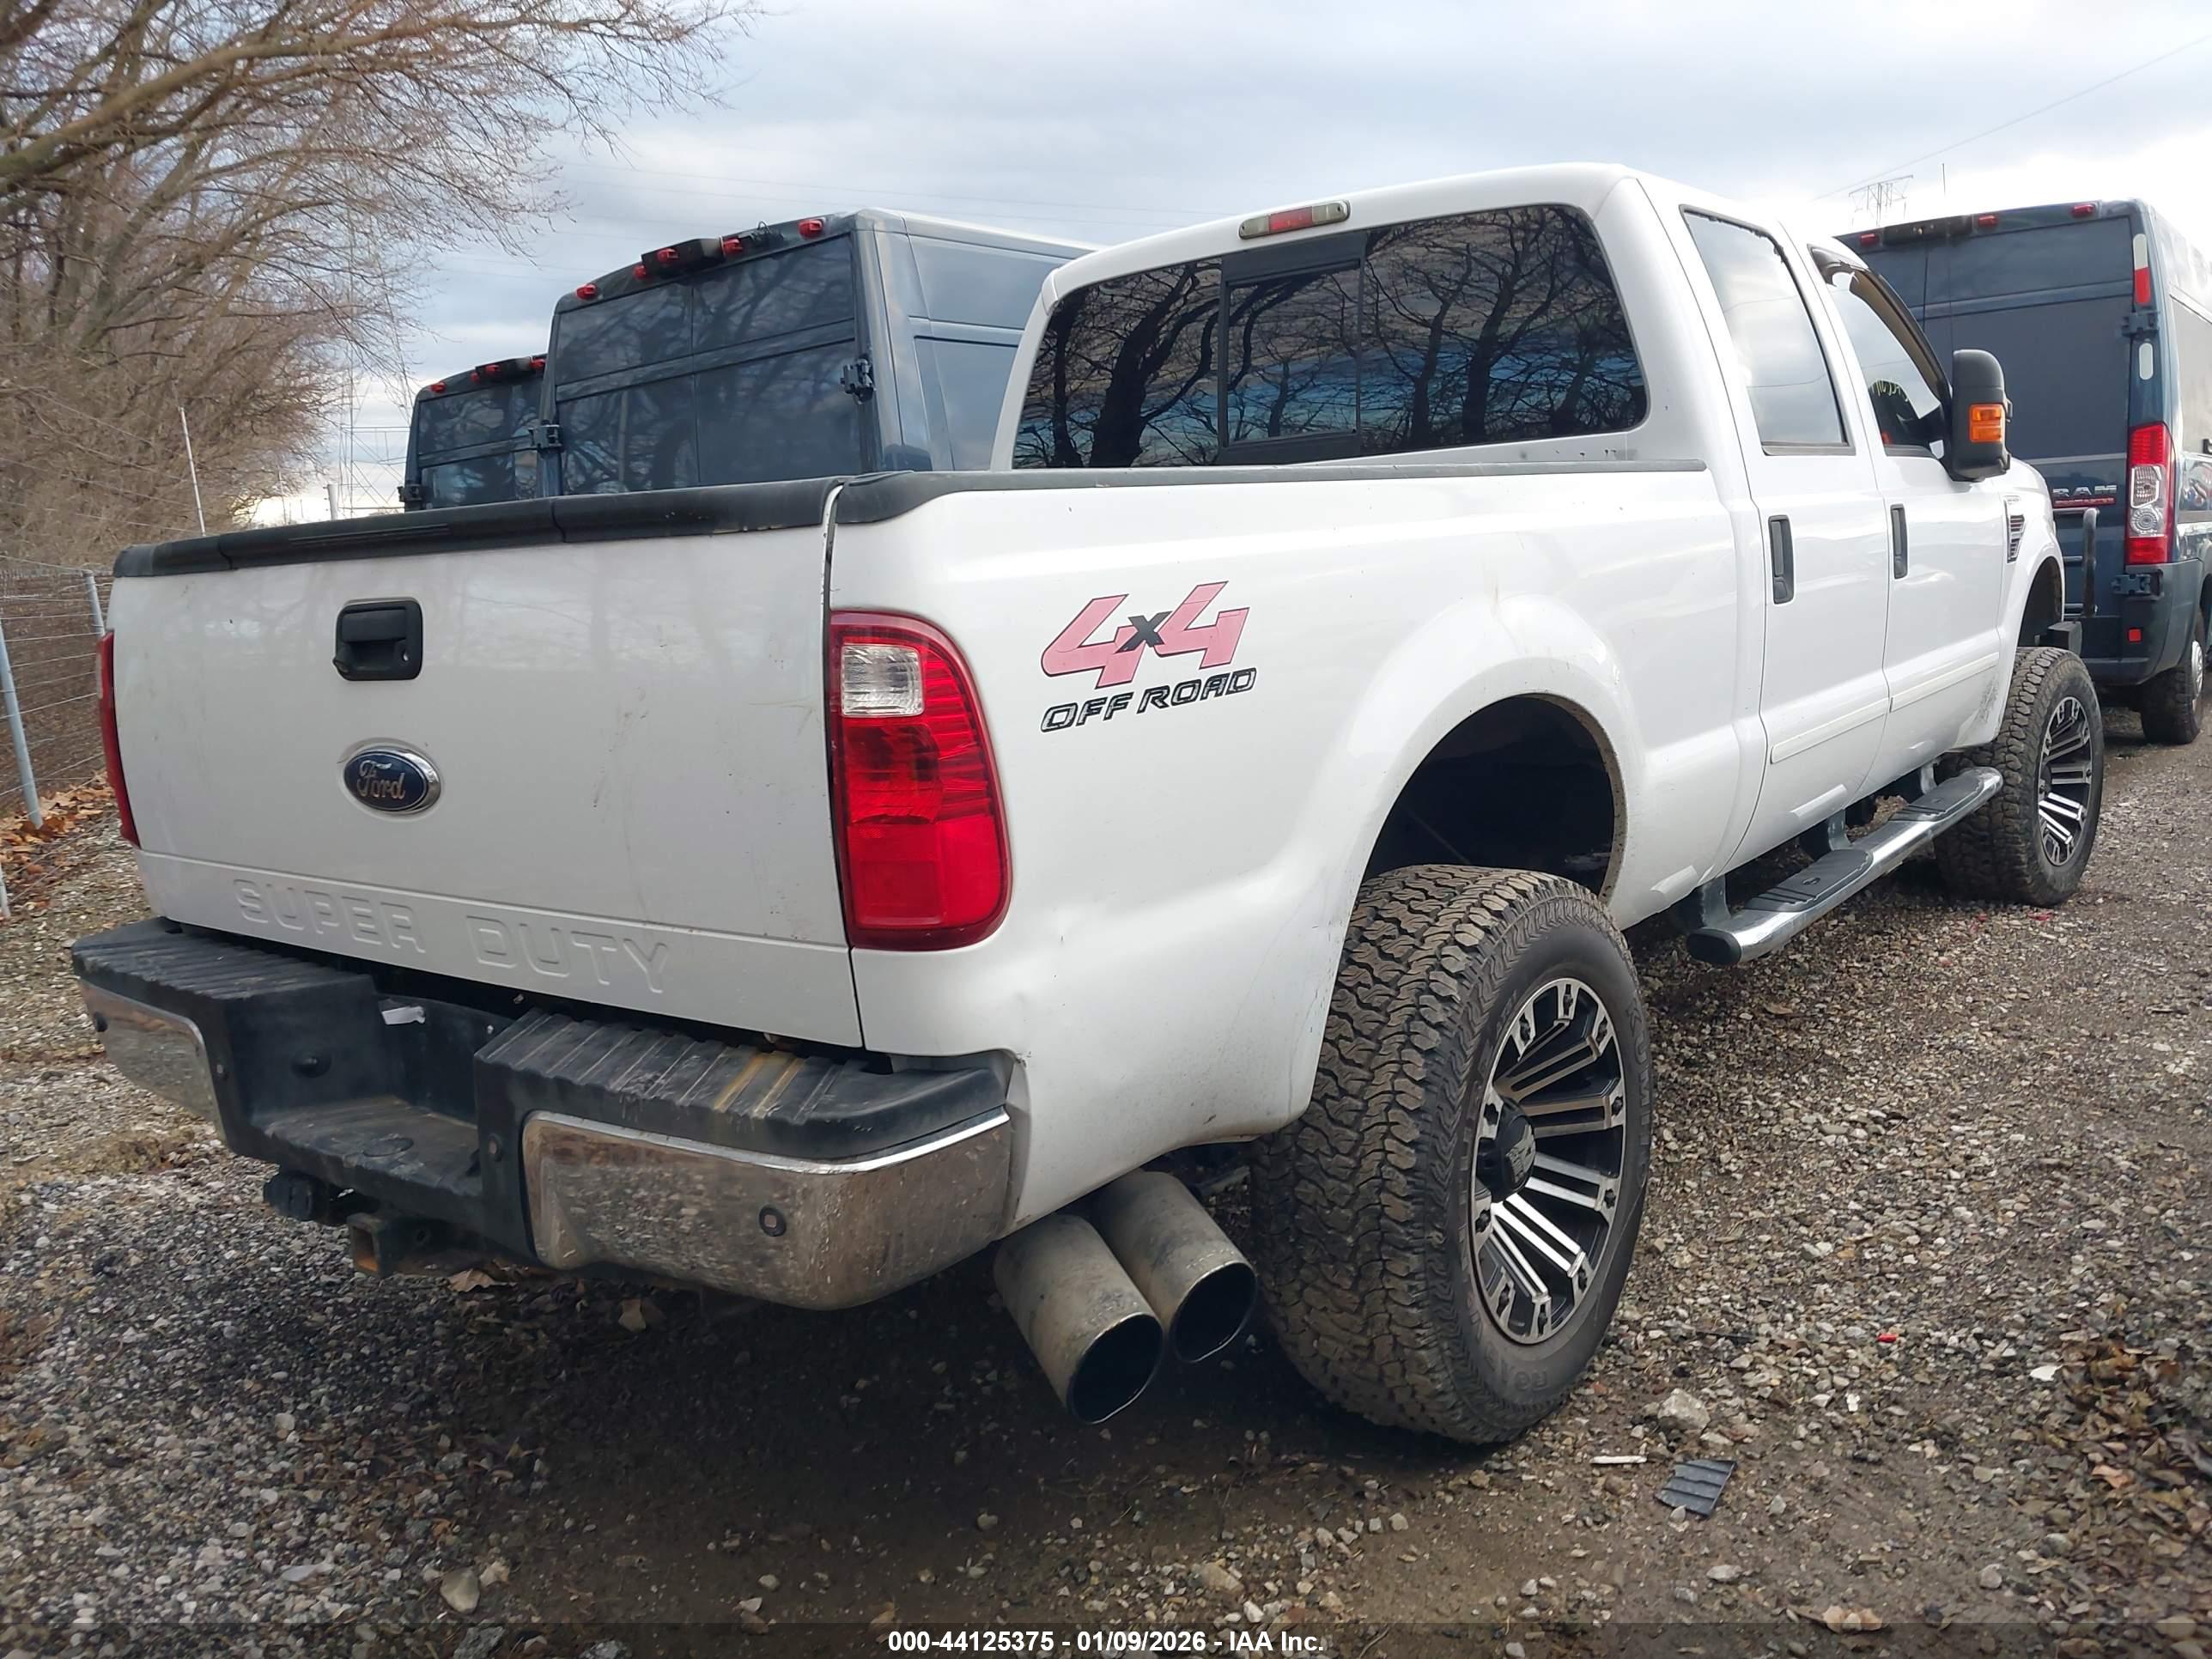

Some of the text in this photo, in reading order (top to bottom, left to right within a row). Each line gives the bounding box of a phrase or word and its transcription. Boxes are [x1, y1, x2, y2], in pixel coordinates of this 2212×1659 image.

[1041, 667, 1257, 732] OFF ROAD
[357, 759, 406, 799] Ford
[233, 878, 669, 994] SUPER DUTY
